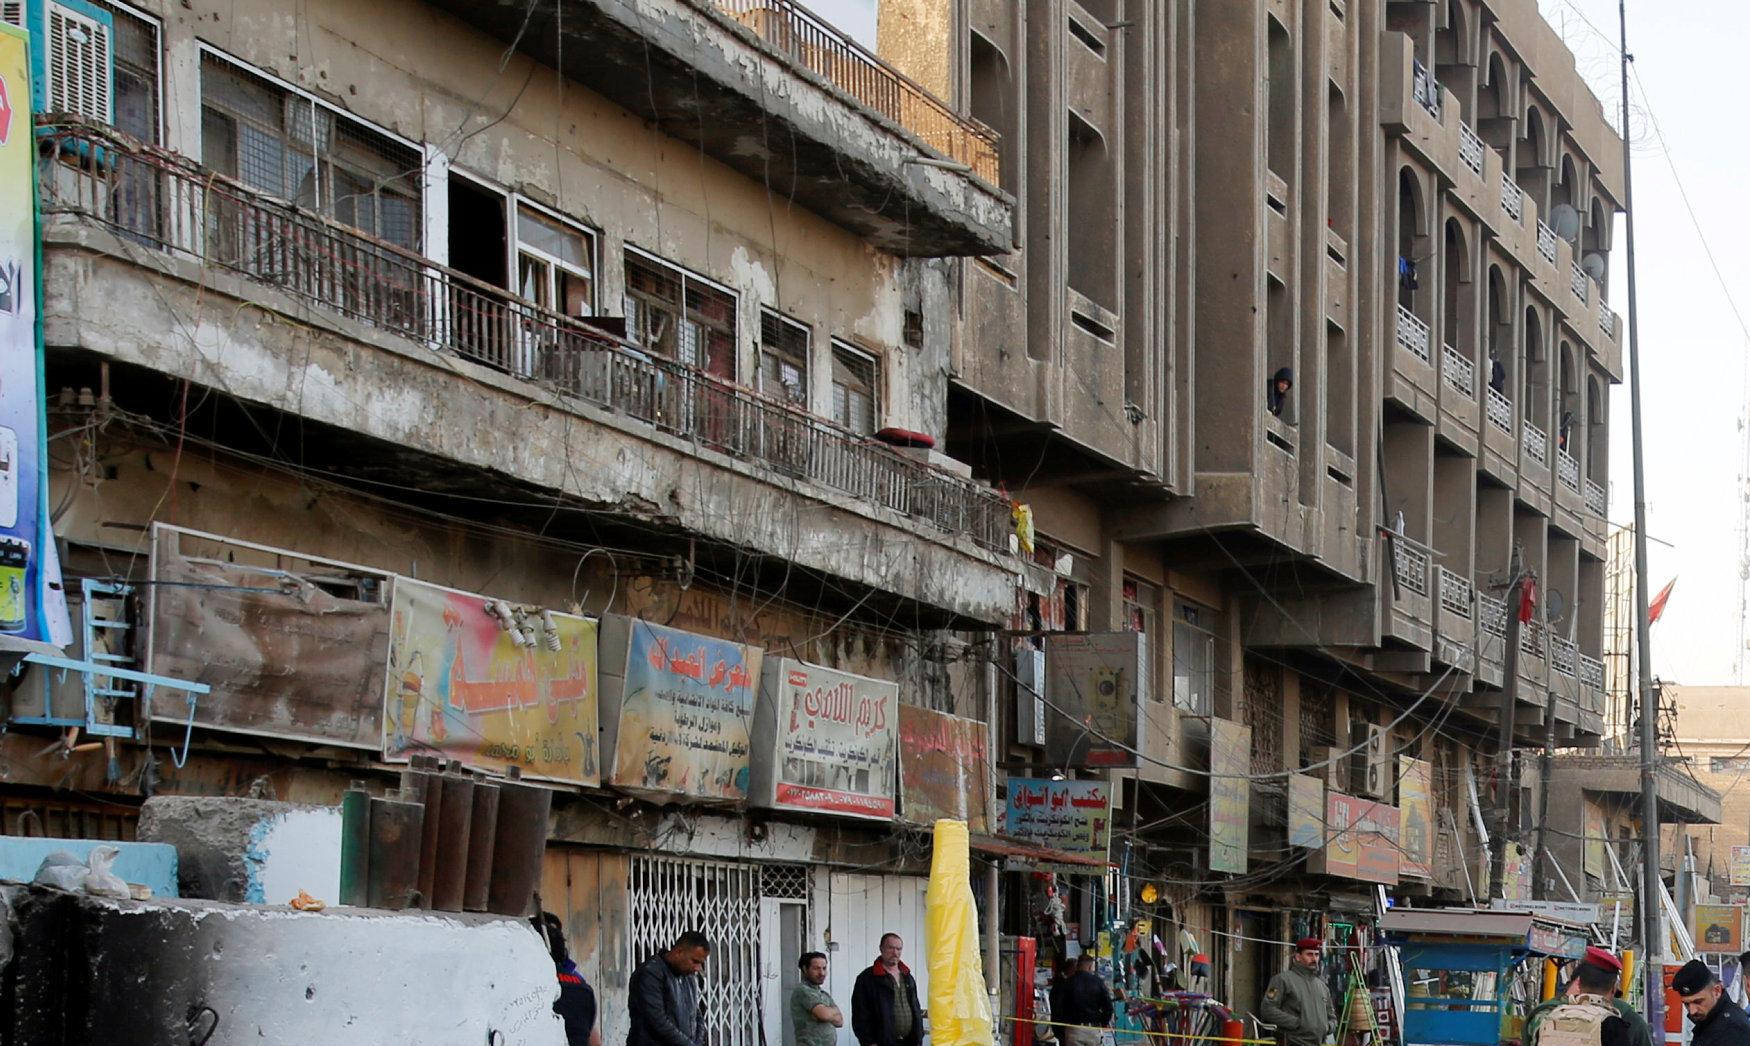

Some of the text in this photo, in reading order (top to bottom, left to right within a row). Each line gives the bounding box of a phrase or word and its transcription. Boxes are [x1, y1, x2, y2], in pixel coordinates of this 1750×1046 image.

[805, 681, 889, 740] كريم اللامي
[1051, 787, 1069, 812] ابو
[1071, 788, 1107, 812] مكتب
